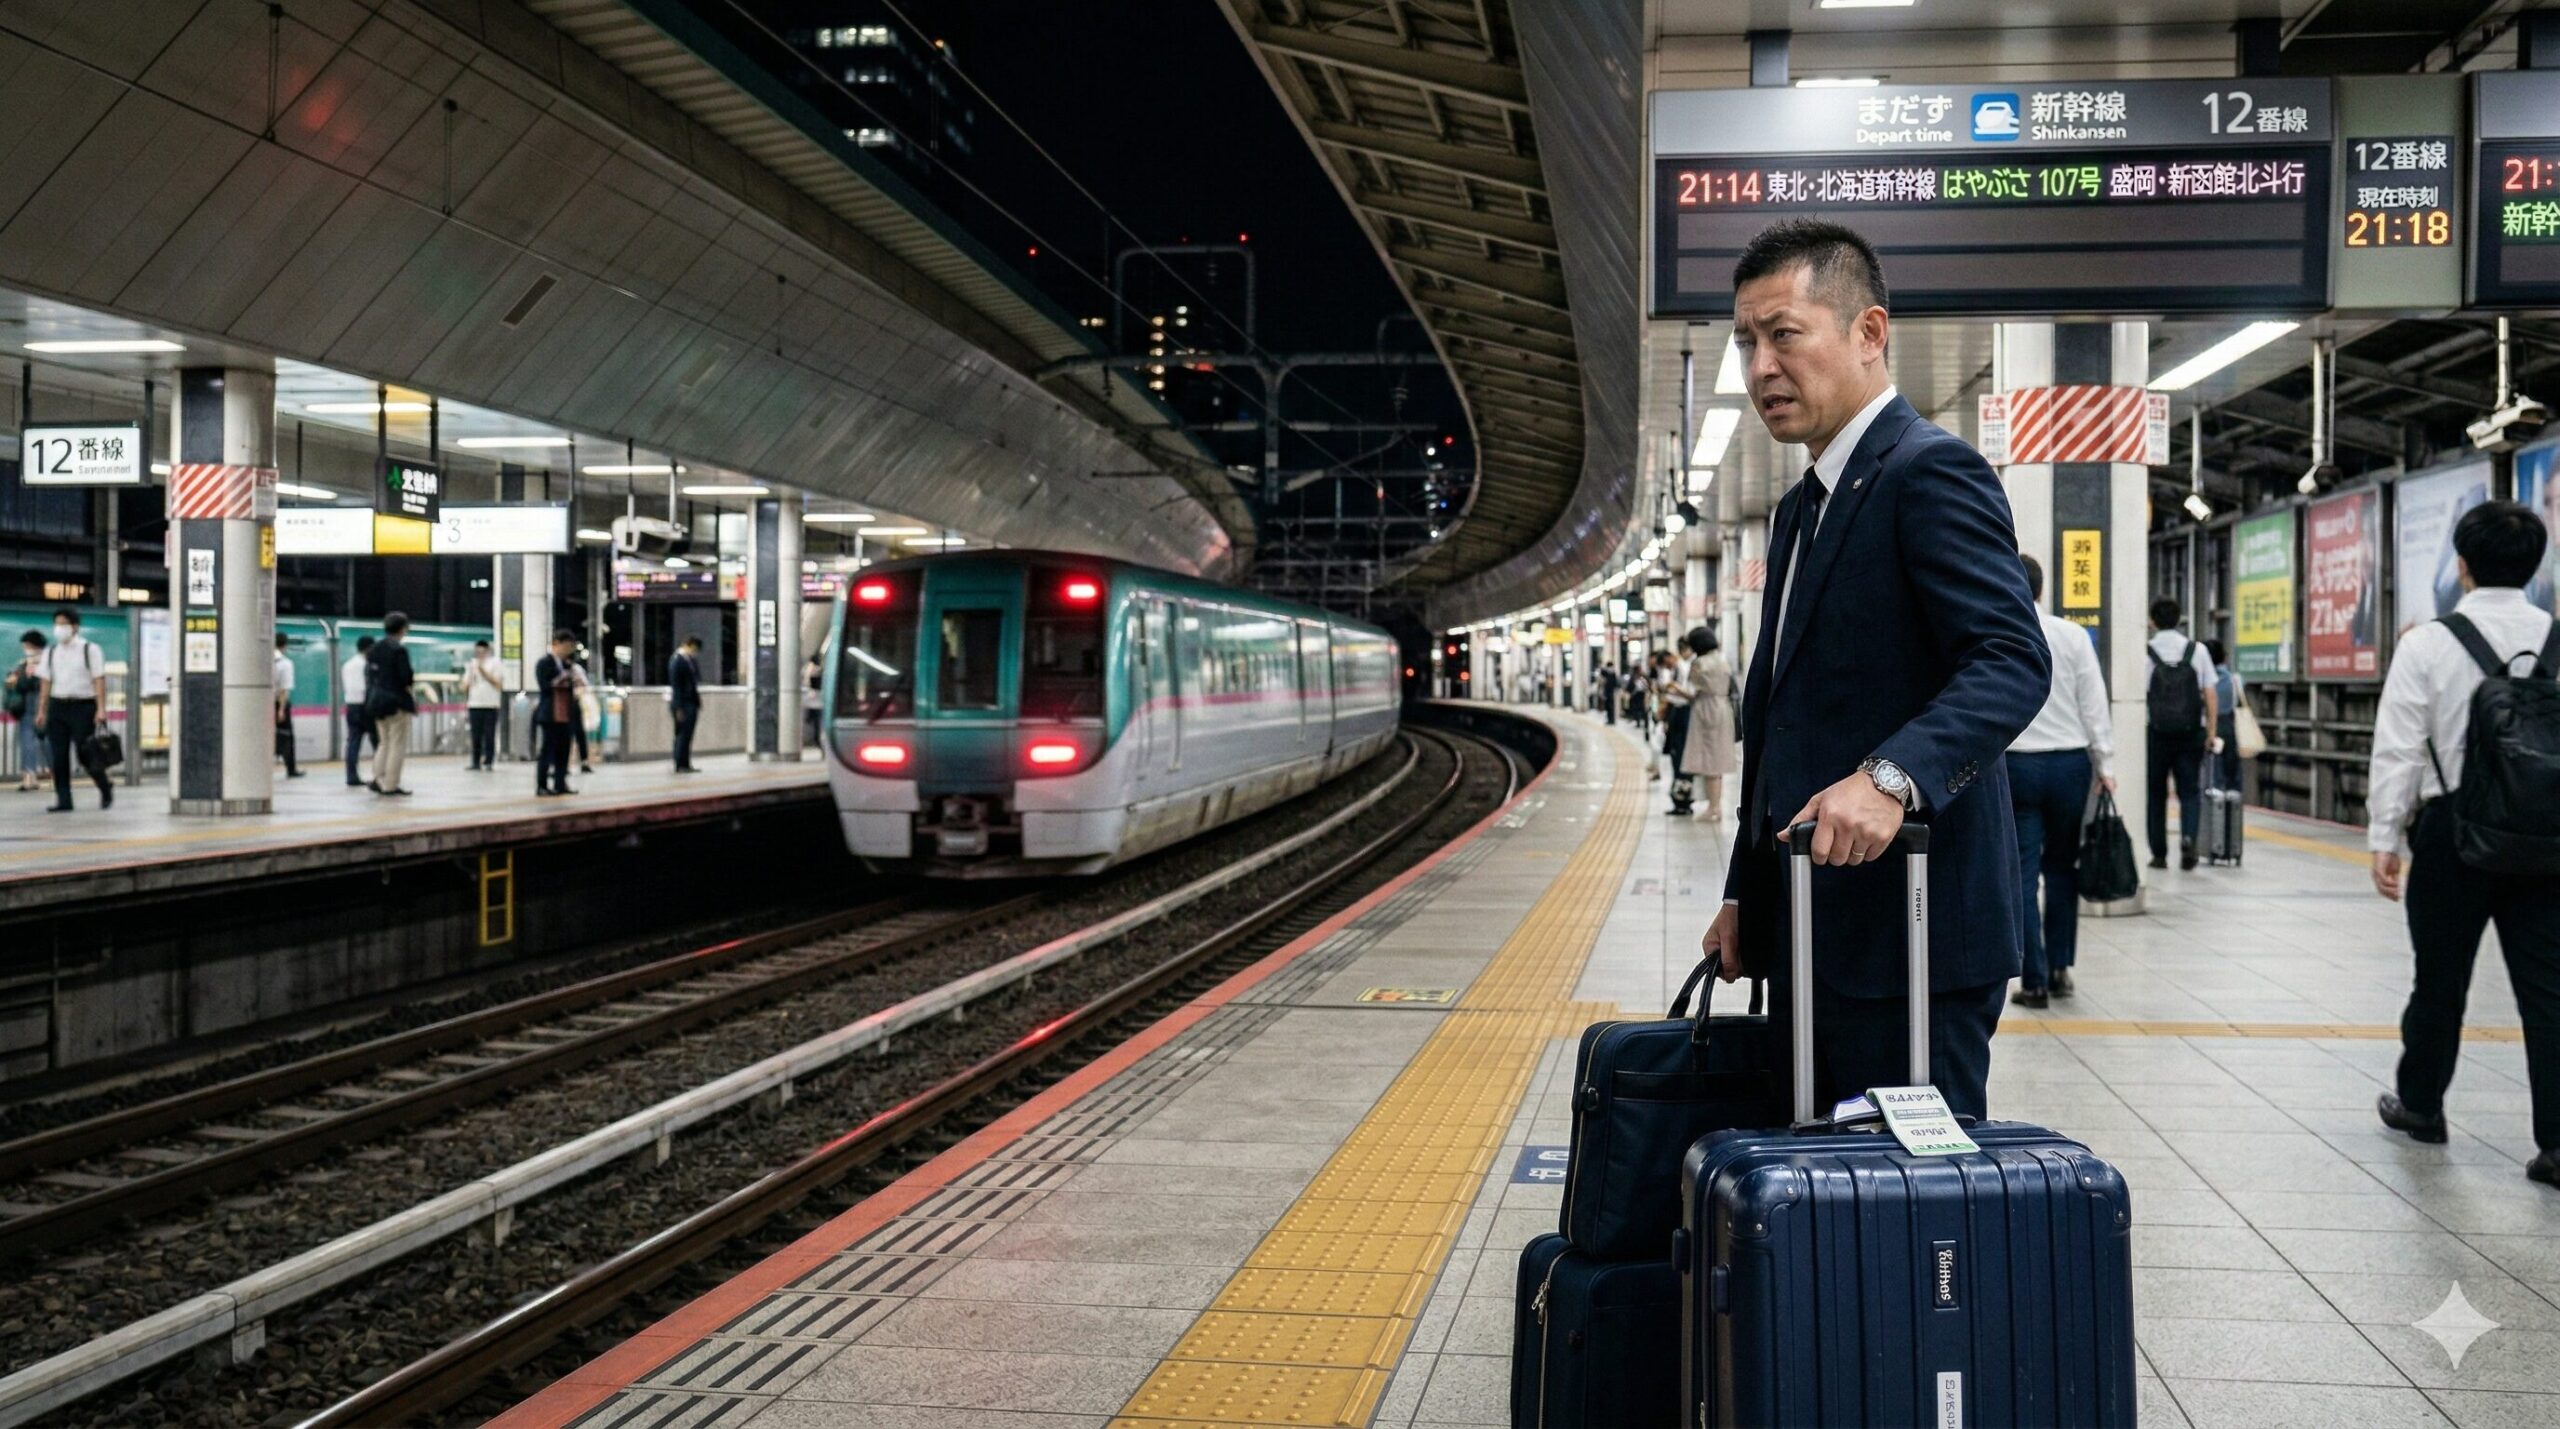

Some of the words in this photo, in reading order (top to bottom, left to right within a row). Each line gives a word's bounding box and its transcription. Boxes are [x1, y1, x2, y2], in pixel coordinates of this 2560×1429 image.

[2031, 91, 2126, 123] 新幹線
[2202, 91, 2308, 134] 12番線
[1856, 127, 1911, 146] Depart
[1915, 127, 1952, 143] time
[2031, 120, 2127, 140] Shinkansen
[2354, 140, 2448, 171] 12番線
[1679, 171, 1761, 203] 21:14
[1943, 168, 2031, 199] はやぶさ
[2038, 166, 2102, 199] 107号
[2505, 158, 2560, 190] 21:
[2357, 186, 2439, 209] 現在時刻
[2348, 210, 2449, 246] 21:18
[31, 436, 124, 475] 12番線
